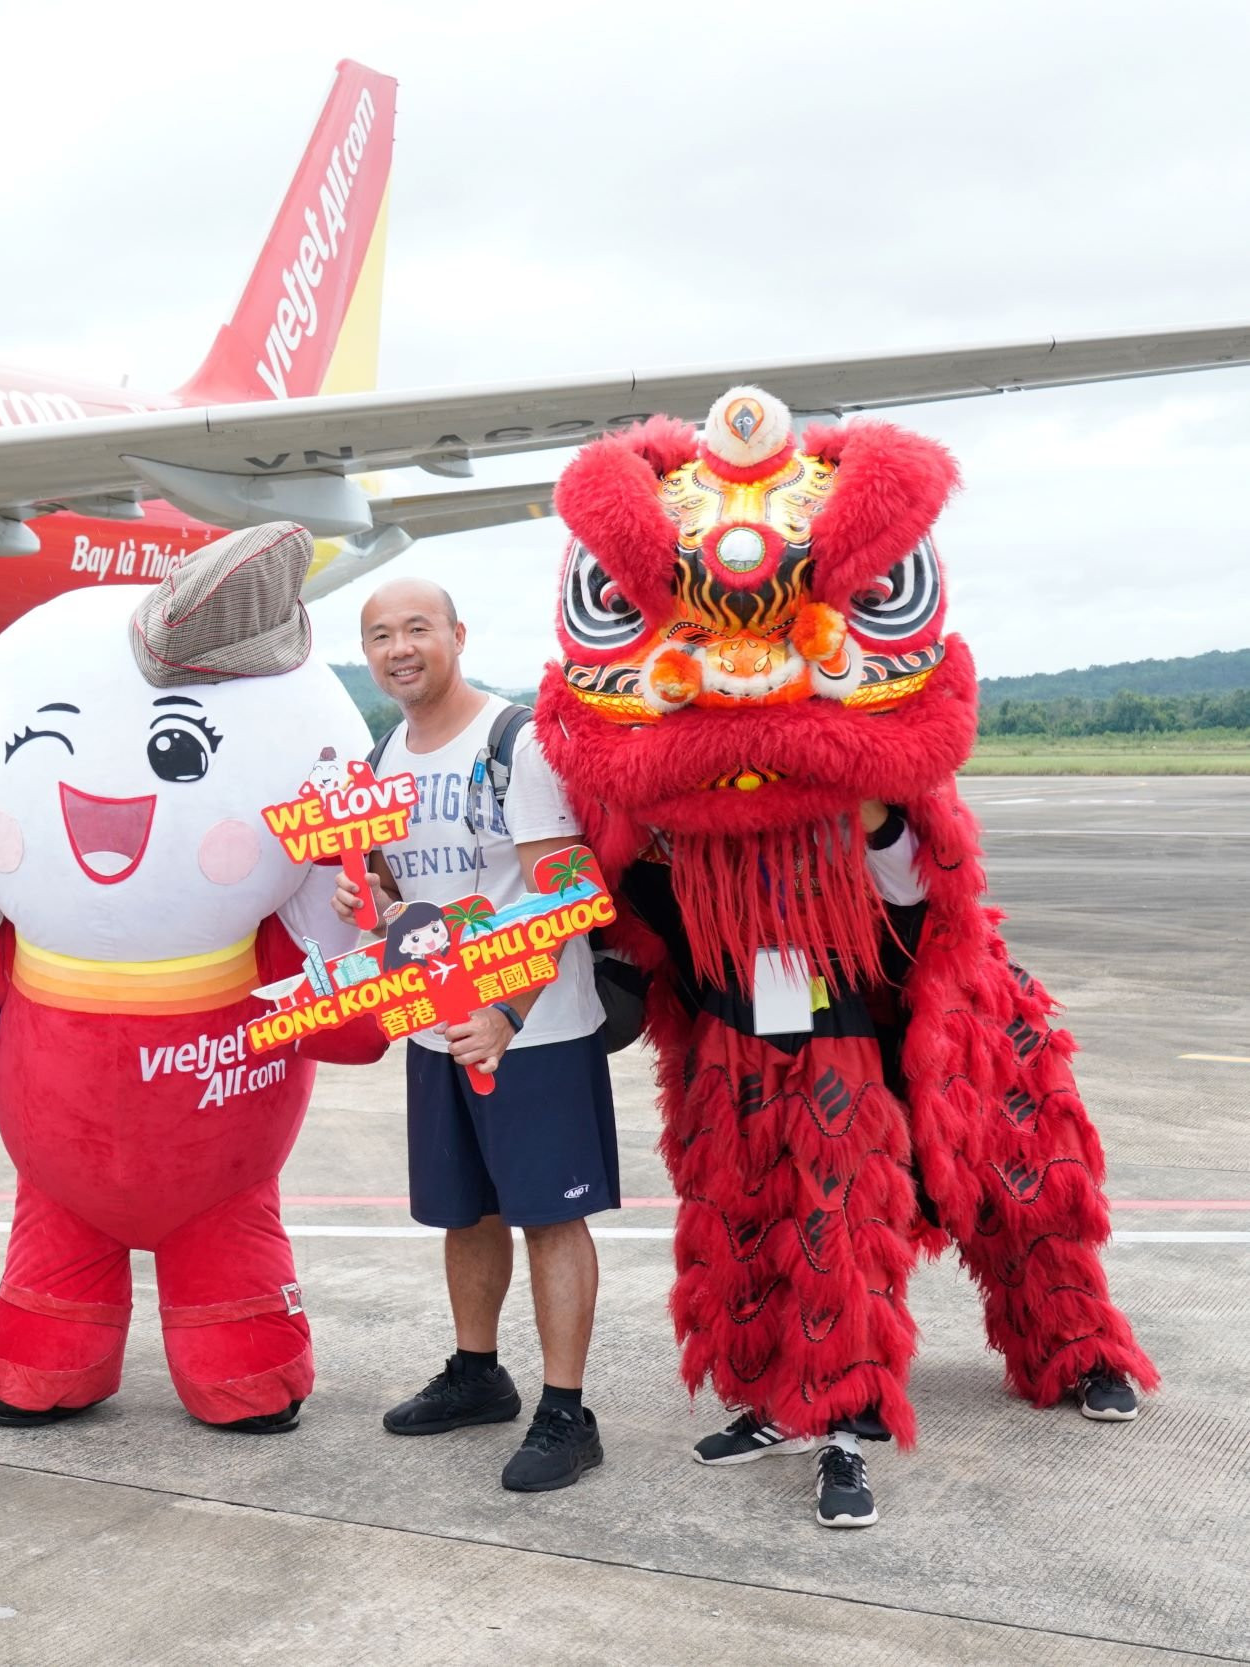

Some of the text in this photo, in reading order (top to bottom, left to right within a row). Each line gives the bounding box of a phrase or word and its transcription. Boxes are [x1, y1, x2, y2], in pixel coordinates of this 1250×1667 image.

[71, 535, 114, 581] Bay
[115, 539, 136, 575] là
[266, 776, 416, 834] WE LOVE
[284, 809, 408, 862] VIETJET
[386, 846, 488, 880] DENIM
[459, 896, 615, 972] PHU QUOC
[472, 953, 556, 1004] 富國島
[250, 967, 427, 1050] HONG KONG
[381, 996, 438, 1037] 香港
